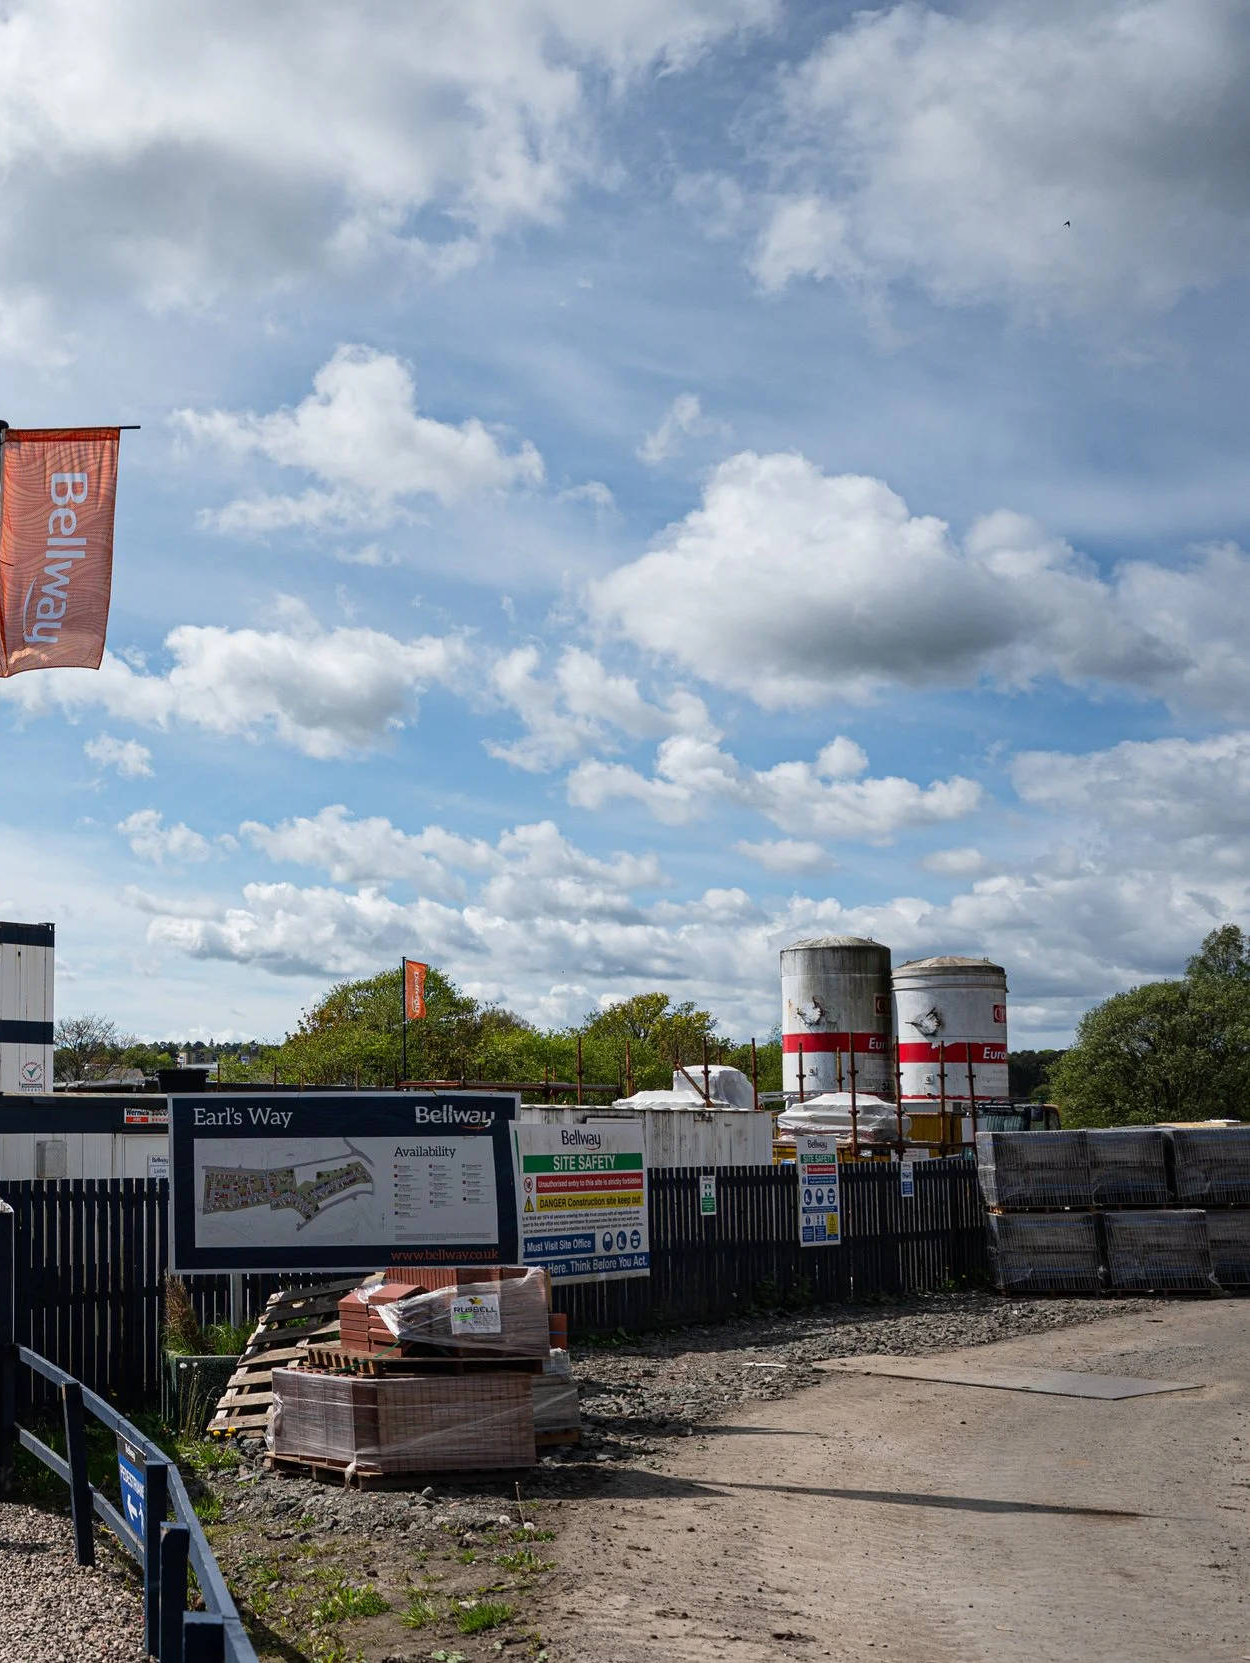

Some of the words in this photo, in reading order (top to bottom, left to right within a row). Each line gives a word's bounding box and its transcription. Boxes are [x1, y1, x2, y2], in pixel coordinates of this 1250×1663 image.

[23, 473, 88, 644] Bellway
[194, 1108, 242, 1126] Earl's
[247, 1108, 292, 1129] Way
[415, 1106, 495, 1129] Bellway
[561, 1130, 601, 1150] Bellway
[394, 1146, 456, 1158] Availability
[553, 1155, 576, 1171] SITE
[578, 1155, 615, 1170] SAFETY
[538, 1180, 567, 1188] Unauthorised
[568, 1180, 579, 1188] entry
[540, 1198, 566, 1208] DANGER
[568, 1197, 605, 1207] Construction
[606, 1196, 616, 1205] site
[617, 1196, 630, 1206] keep
[632, 1195, 641, 1203] out
[526, 1242, 544, 1253] Must
[545, 1241, 557, 1252] Visit
[558, 1240, 571, 1250] Site
[573, 1238, 591, 1248] Office
[391, 1249, 498, 1260] www.bellway.co.uk
[570, 1260, 591, 1273] Think
[593, 1258, 616, 1271] Before
[618, 1257, 631, 1268] You
[633, 1255, 648, 1266] Act.
